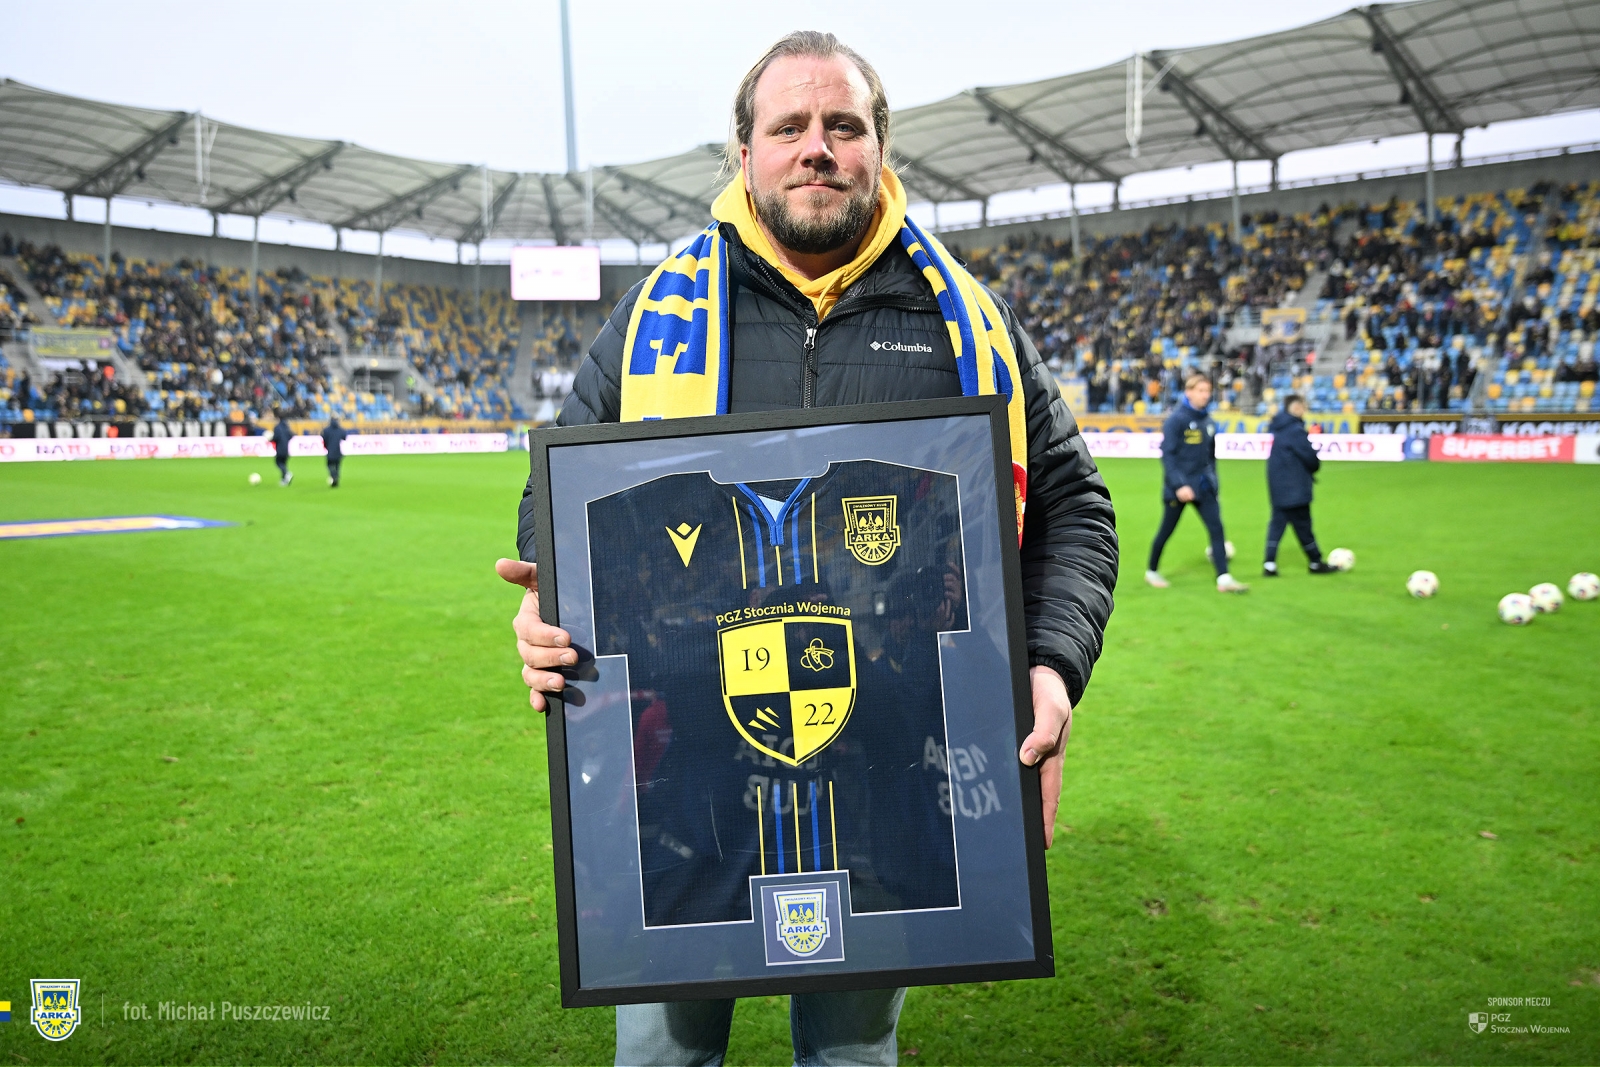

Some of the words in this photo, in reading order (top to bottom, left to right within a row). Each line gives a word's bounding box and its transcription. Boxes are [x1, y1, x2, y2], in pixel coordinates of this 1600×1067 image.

[881, 341, 933, 353] Columbia
[1441, 436, 1562, 460] SUPERBET
[855, 532, 891, 543] ARKA
[715, 609, 743, 626] PGZ
[743, 602, 795, 619] Stocznia
[796, 601, 851, 617] Wojenna
[741, 646, 771, 672] 19
[803, 702, 837, 727] 22
[787, 925, 820, 933] ARKA
